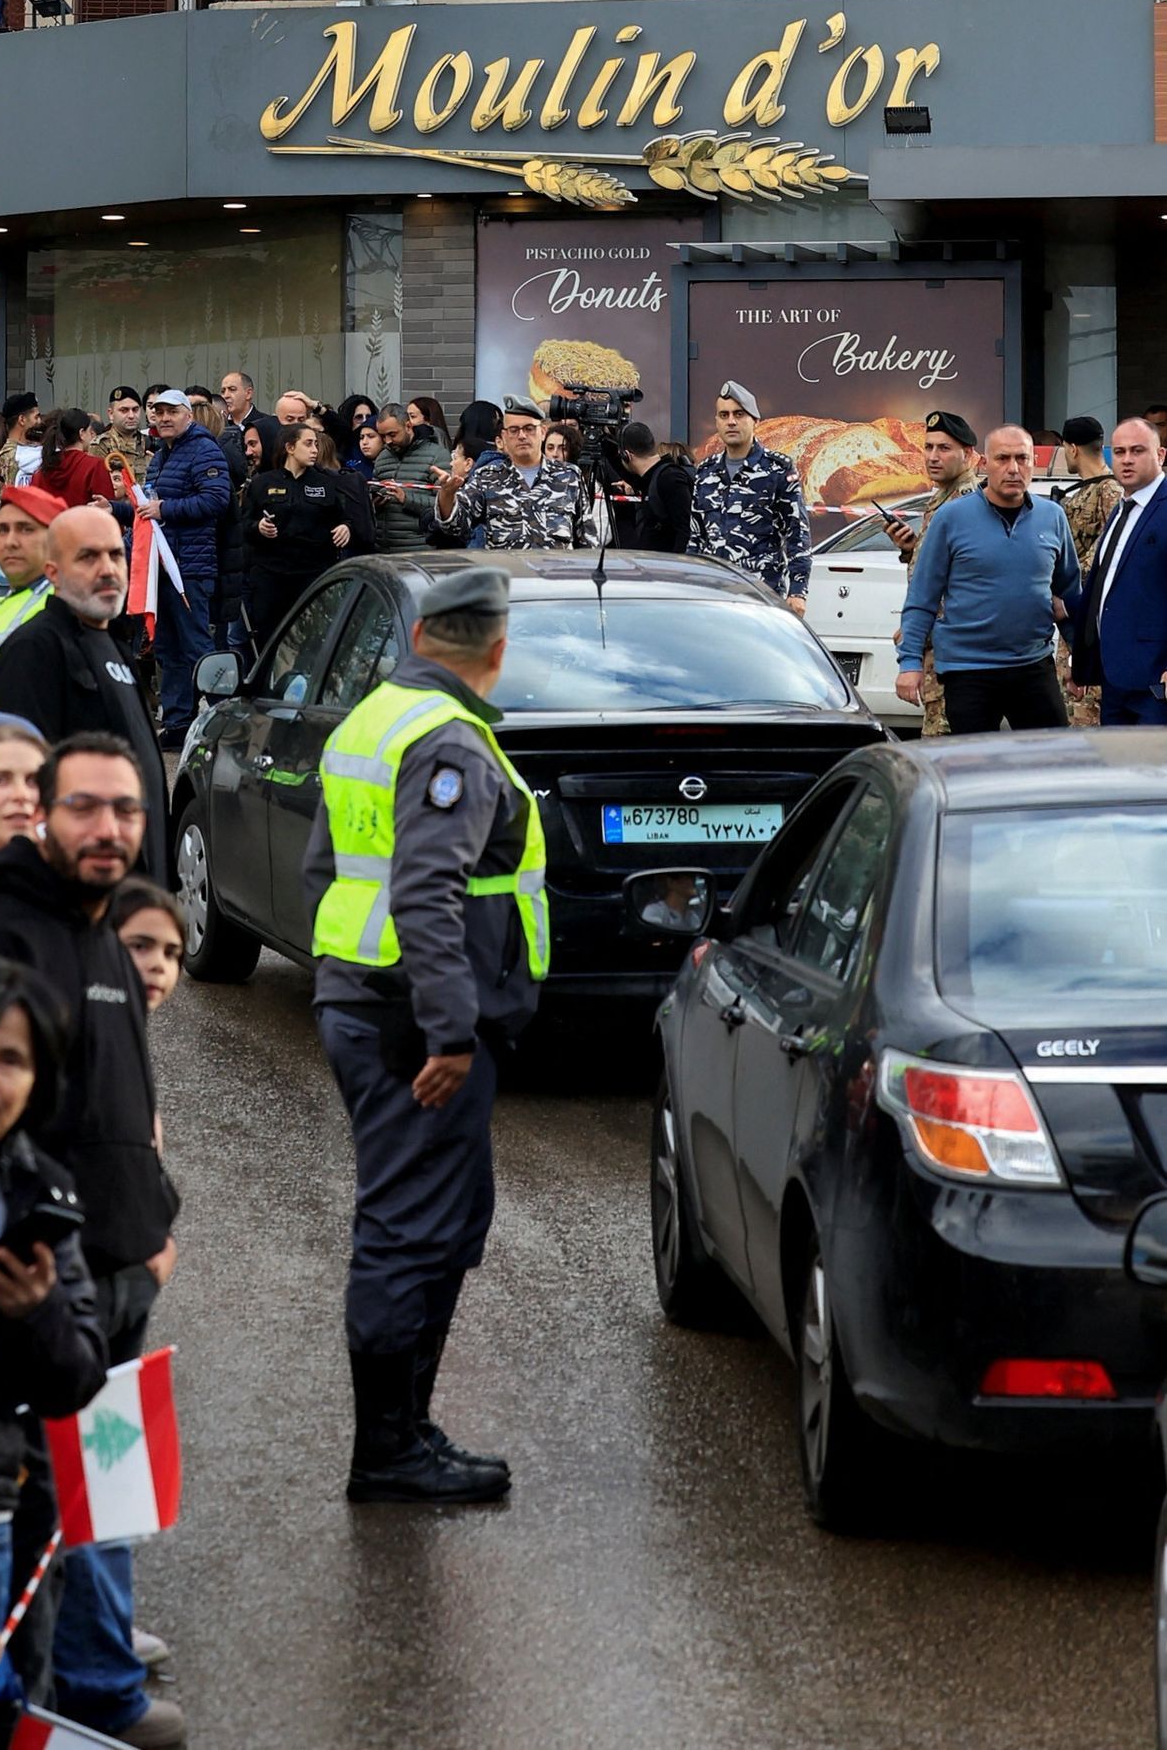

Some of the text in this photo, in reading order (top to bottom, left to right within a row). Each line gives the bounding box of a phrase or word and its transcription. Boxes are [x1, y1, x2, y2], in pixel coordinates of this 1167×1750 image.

[259, 12, 941, 140] Moulin d'or
[525, 247, 651, 260] PISTACHIO GOLD
[512, 267, 668, 321] Donuts
[735, 309, 842, 324] THE ART OF
[797, 331, 959, 390] Bakery
[1036, 1038, 1102, 1057] GEELY
